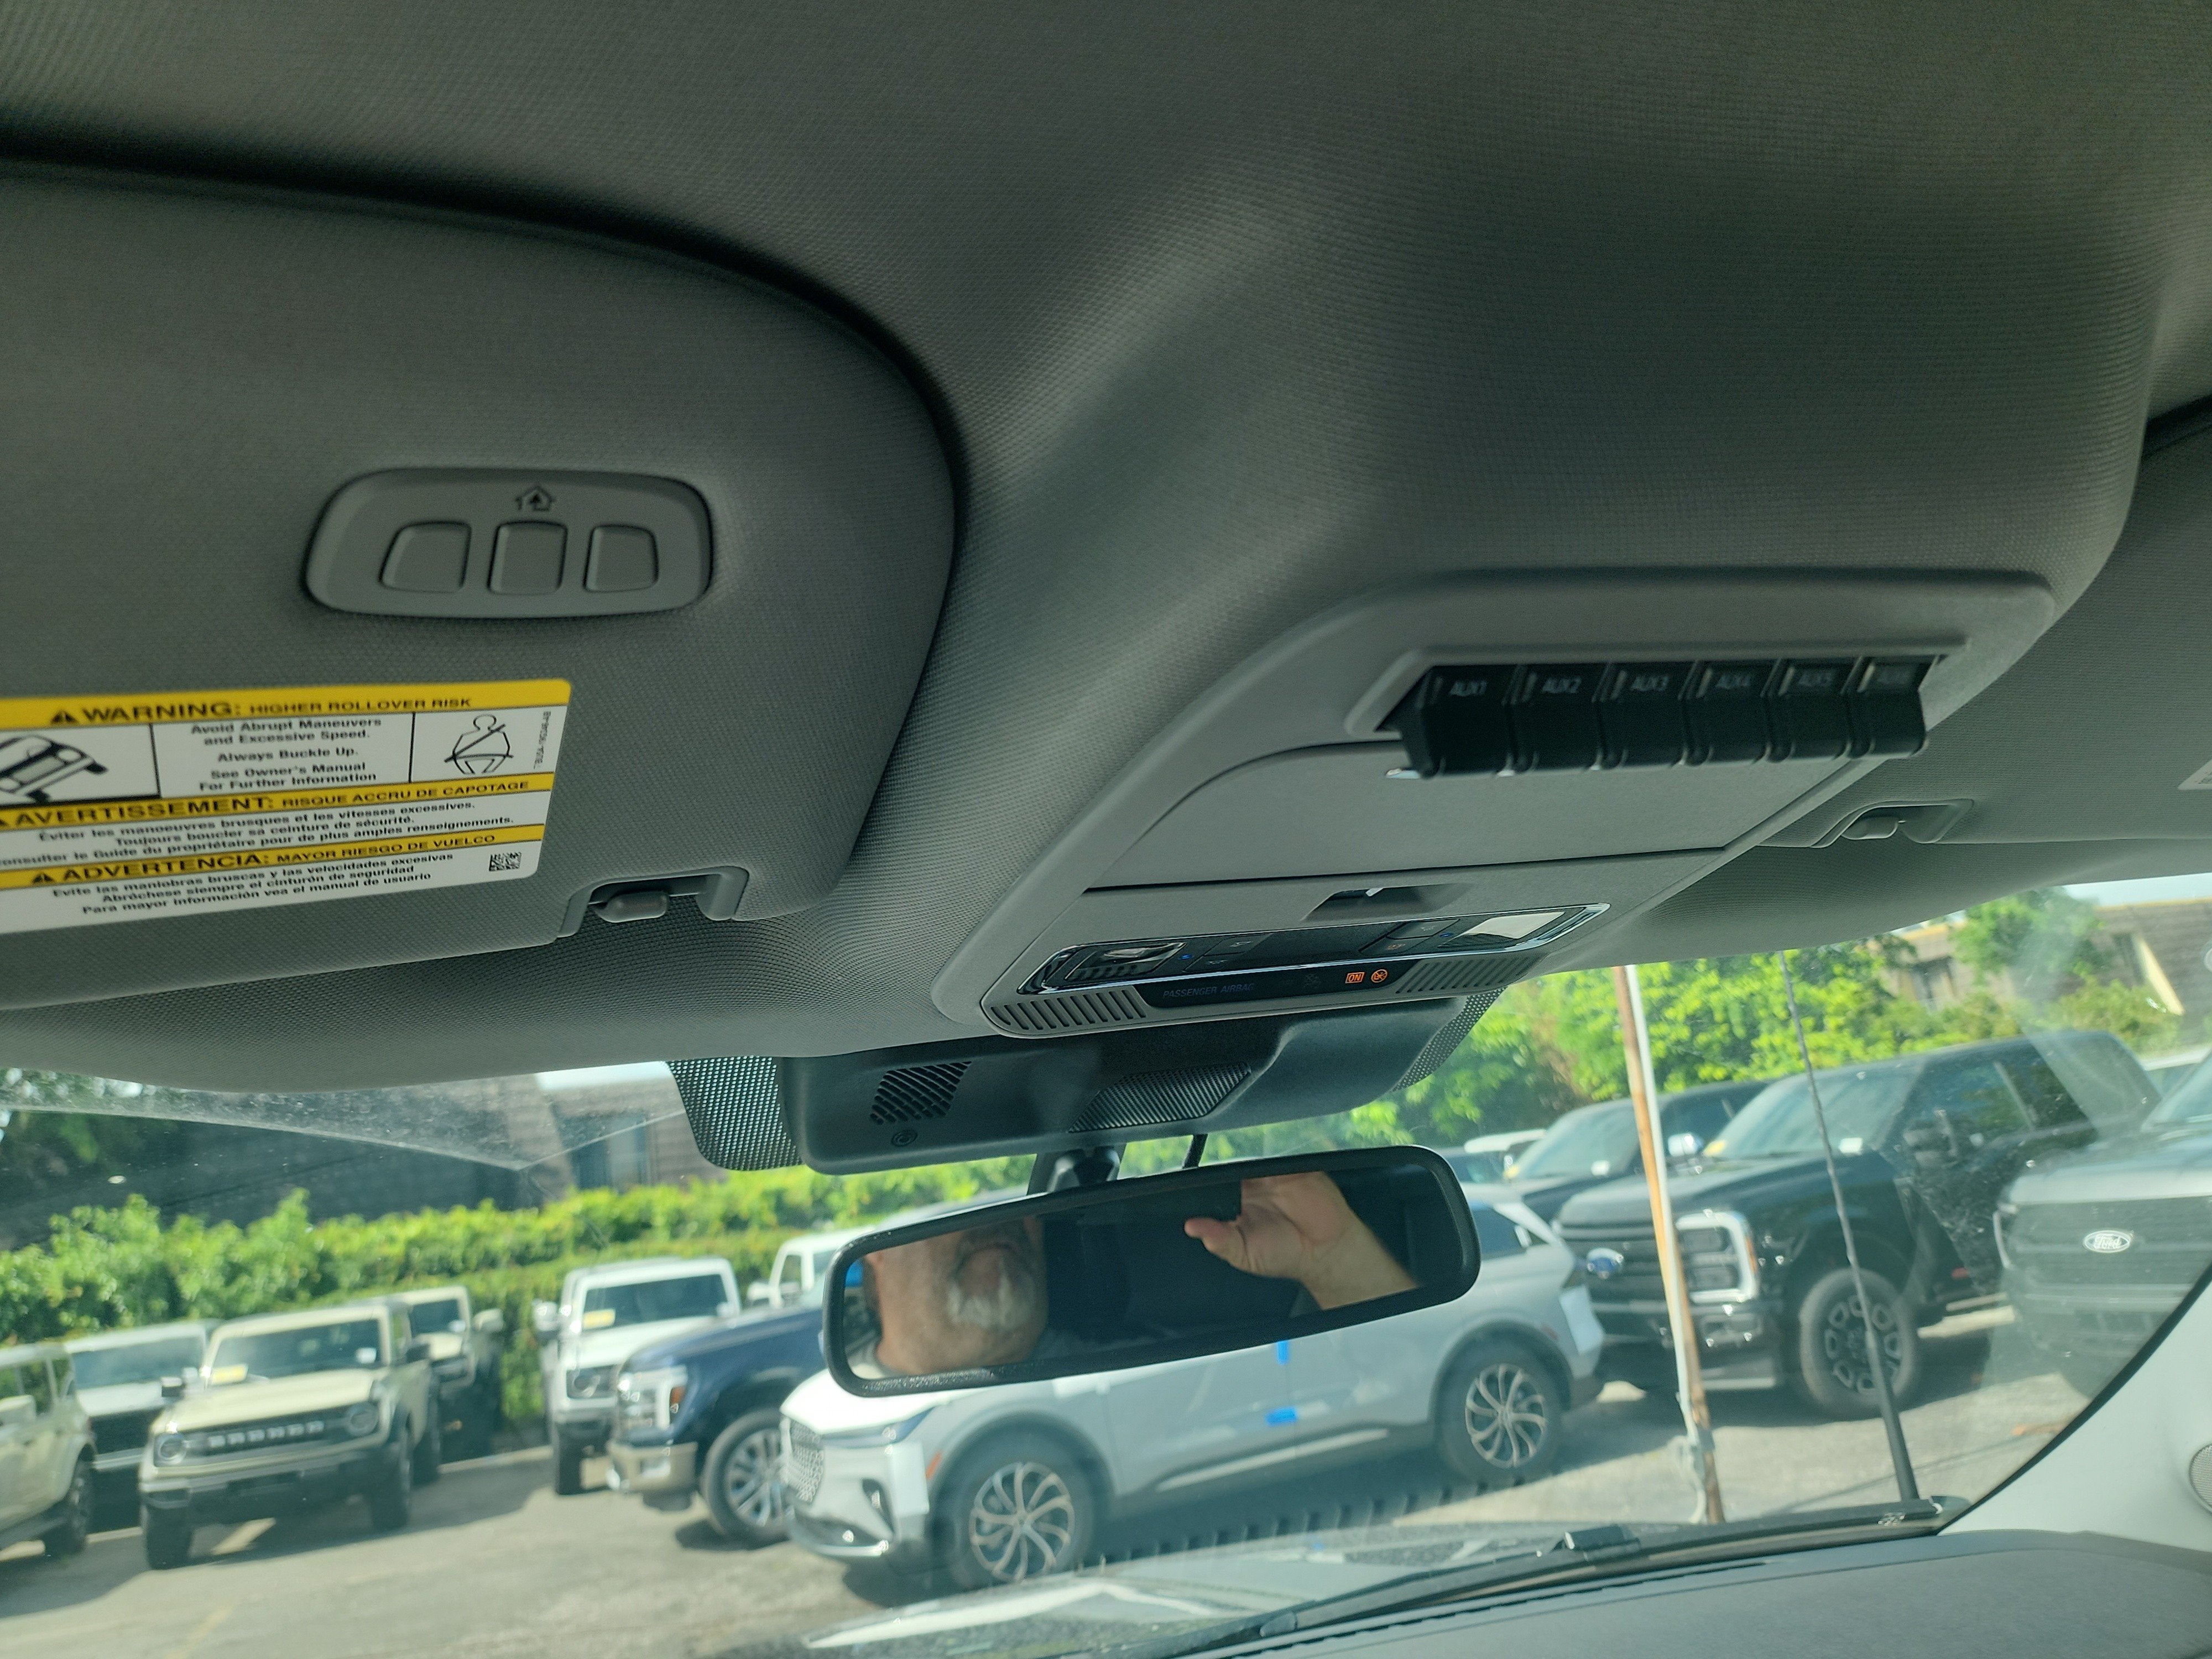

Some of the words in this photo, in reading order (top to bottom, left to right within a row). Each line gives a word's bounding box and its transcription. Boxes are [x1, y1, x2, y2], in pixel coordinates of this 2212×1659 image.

[1449, 680, 1487, 697] AUX1
[1542, 676, 1582, 694] AUX2
[82, 702, 240, 722] WARNING:
[250, 702, 321, 713] HIGHER
[328, 699, 425, 710] ROLLOVER
[431, 698, 471, 708] RISK
[191, 723, 234, 734] Avoid
[241, 720, 292, 731] Abrupt
[299, 719, 382, 729] Maneuvers
[204, 735, 233, 745] and
[239, 732, 315, 743] Excessive
[321, 729, 369, 741] Speed.
[218, 753, 273, 763] Always
[279, 749, 330, 759] Buckle
[336, 747, 358, 758] Up.
[200, 781, 222, 791] For
[230, 778, 284, 789] Further
[292, 774, 376, 785] Information
[211, 770, 239, 779] See
[245, 765, 306, 776] Owner's
[312, 762, 365, 773] Manual
[15, 797, 274, 825] AVERTISSEMENT:
[282, 796, 347, 807] RISQUE
[352, 791, 411, 802] ACCRU
[416, 789, 437, 799] DE
[442, 781, 529, 795] CAPOTAGE
[120, 822, 216, 835] manoeuvres
[221, 818, 289, 828] brusques
[295, 813, 308, 822] et
[314, 812, 333, 821] les
[339, 808, 395, 818] vitesses
[400, 803, 474, 814] excessives.
[0, 855, 67, 865] onsulter
[74, 851, 88, 860] le
[94, 849, 138, 858] Guide
[260, 837, 292, 847] pour
[320, 831, 349, 842] plus
[354, 827, 403, 837] amples
[407, 817, 514, 833] renseignements.
[116, 836, 181, 847] Toujours
[187, 830, 242, 841] boucler
[270, 825, 329, 834] ceinture
[334, 821, 351, 830] de
[64, 855, 269, 880] ADVERTENCIA:
[277, 851, 336, 862] MAYOR
[341, 844, 403, 855] RIESGO
[408, 842, 428, 851] DE
[434, 835, 495, 847] VUELCO
[53, 888, 91, 897] Evite
[96, 885, 118, 894] las
[123, 879, 202, 891] maniobras
[208, 872, 265, 884] bruscas
[283, 867, 303, 876] las
[307, 862, 387, 874] velocidades
[391, 854, 453, 865] excesivas
[187, 884, 244, 894] siempre
[349, 865, 414, 879] seguridad
[83, 905, 117, 914] Para
[123, 900, 168, 911] mayor
[265, 889, 288, 897] vea
[293, 885, 305, 894] el
[310, 879, 359, 891] manual
[364, 878, 379, 886] de
[384, 873, 431, 885] usuario
[1162, 987, 1217, 997] PASSENGER
[1220, 983, 1254, 994] AIRBAG
